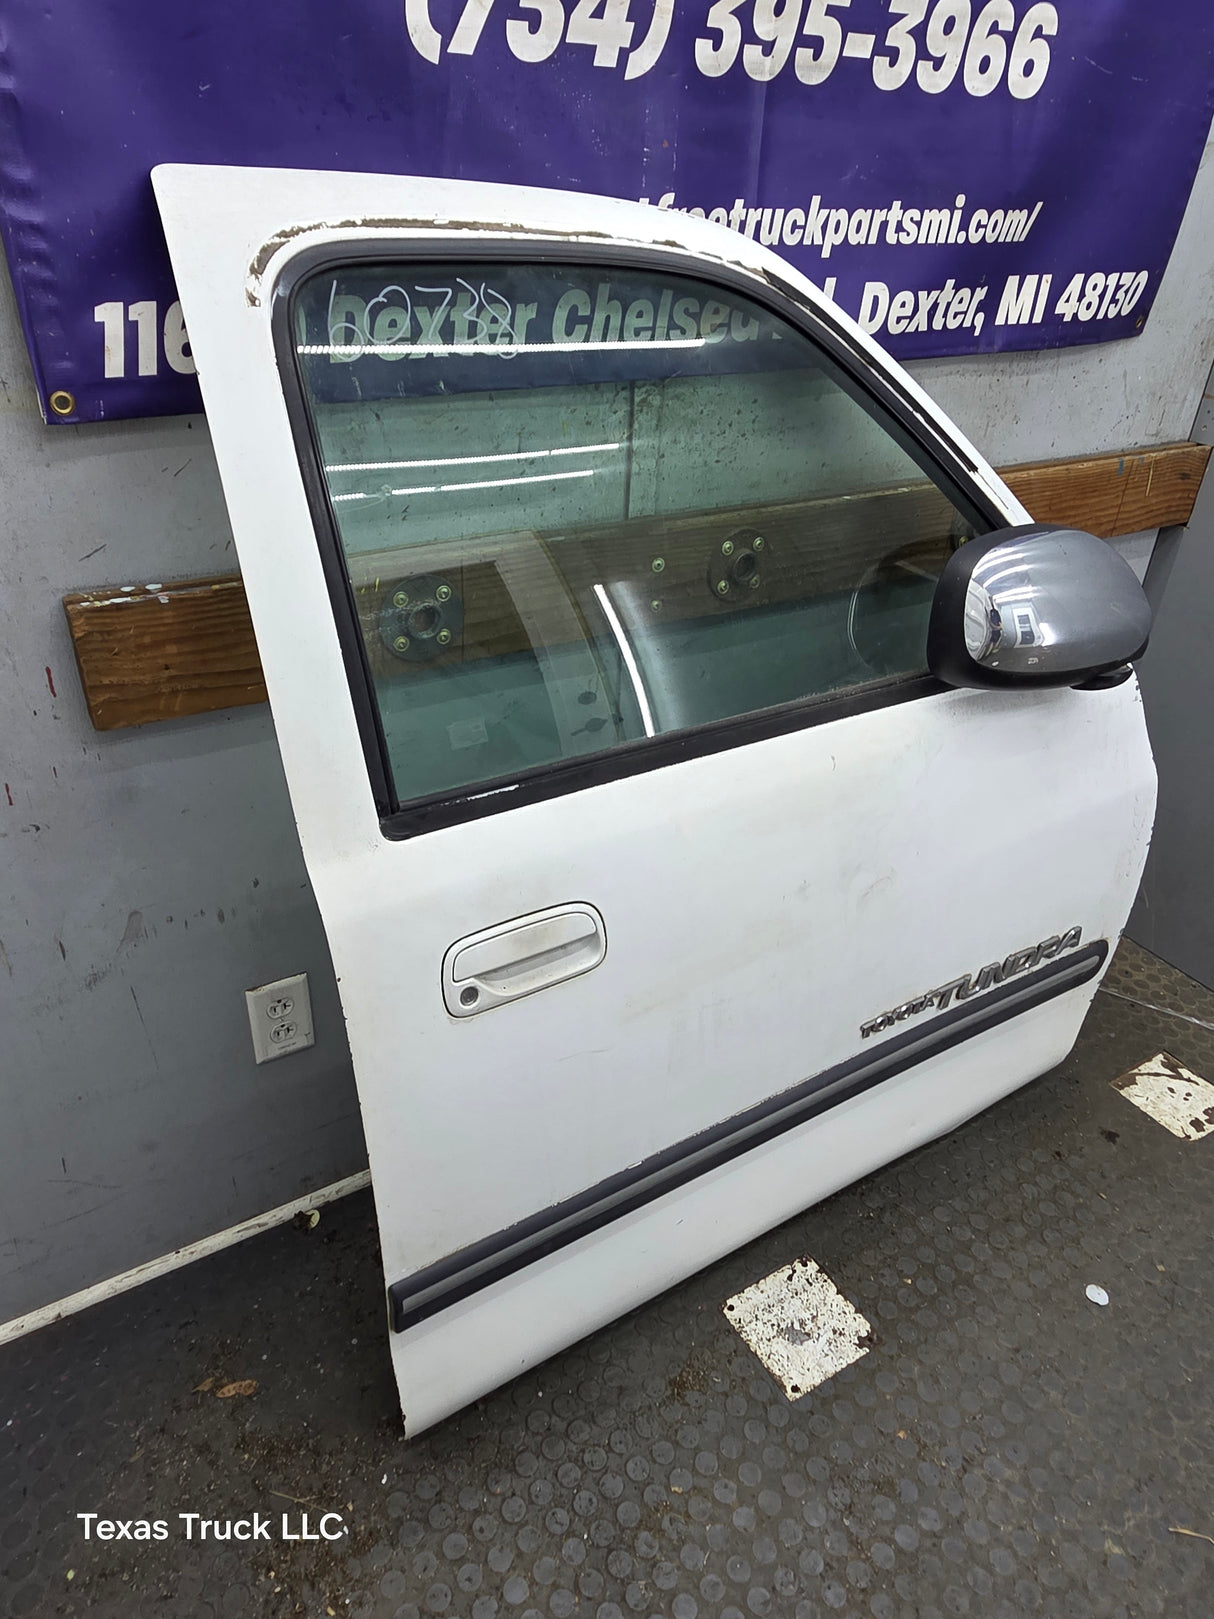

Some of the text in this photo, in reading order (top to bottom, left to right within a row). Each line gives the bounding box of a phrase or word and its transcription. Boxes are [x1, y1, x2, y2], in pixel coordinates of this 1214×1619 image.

[694, 0, 1059, 100] 395-3966
[994, 274, 1049, 326] MI
[1055, 270, 1148, 322] 48130
[936, 925, 1082, 1011] TUNDRA
